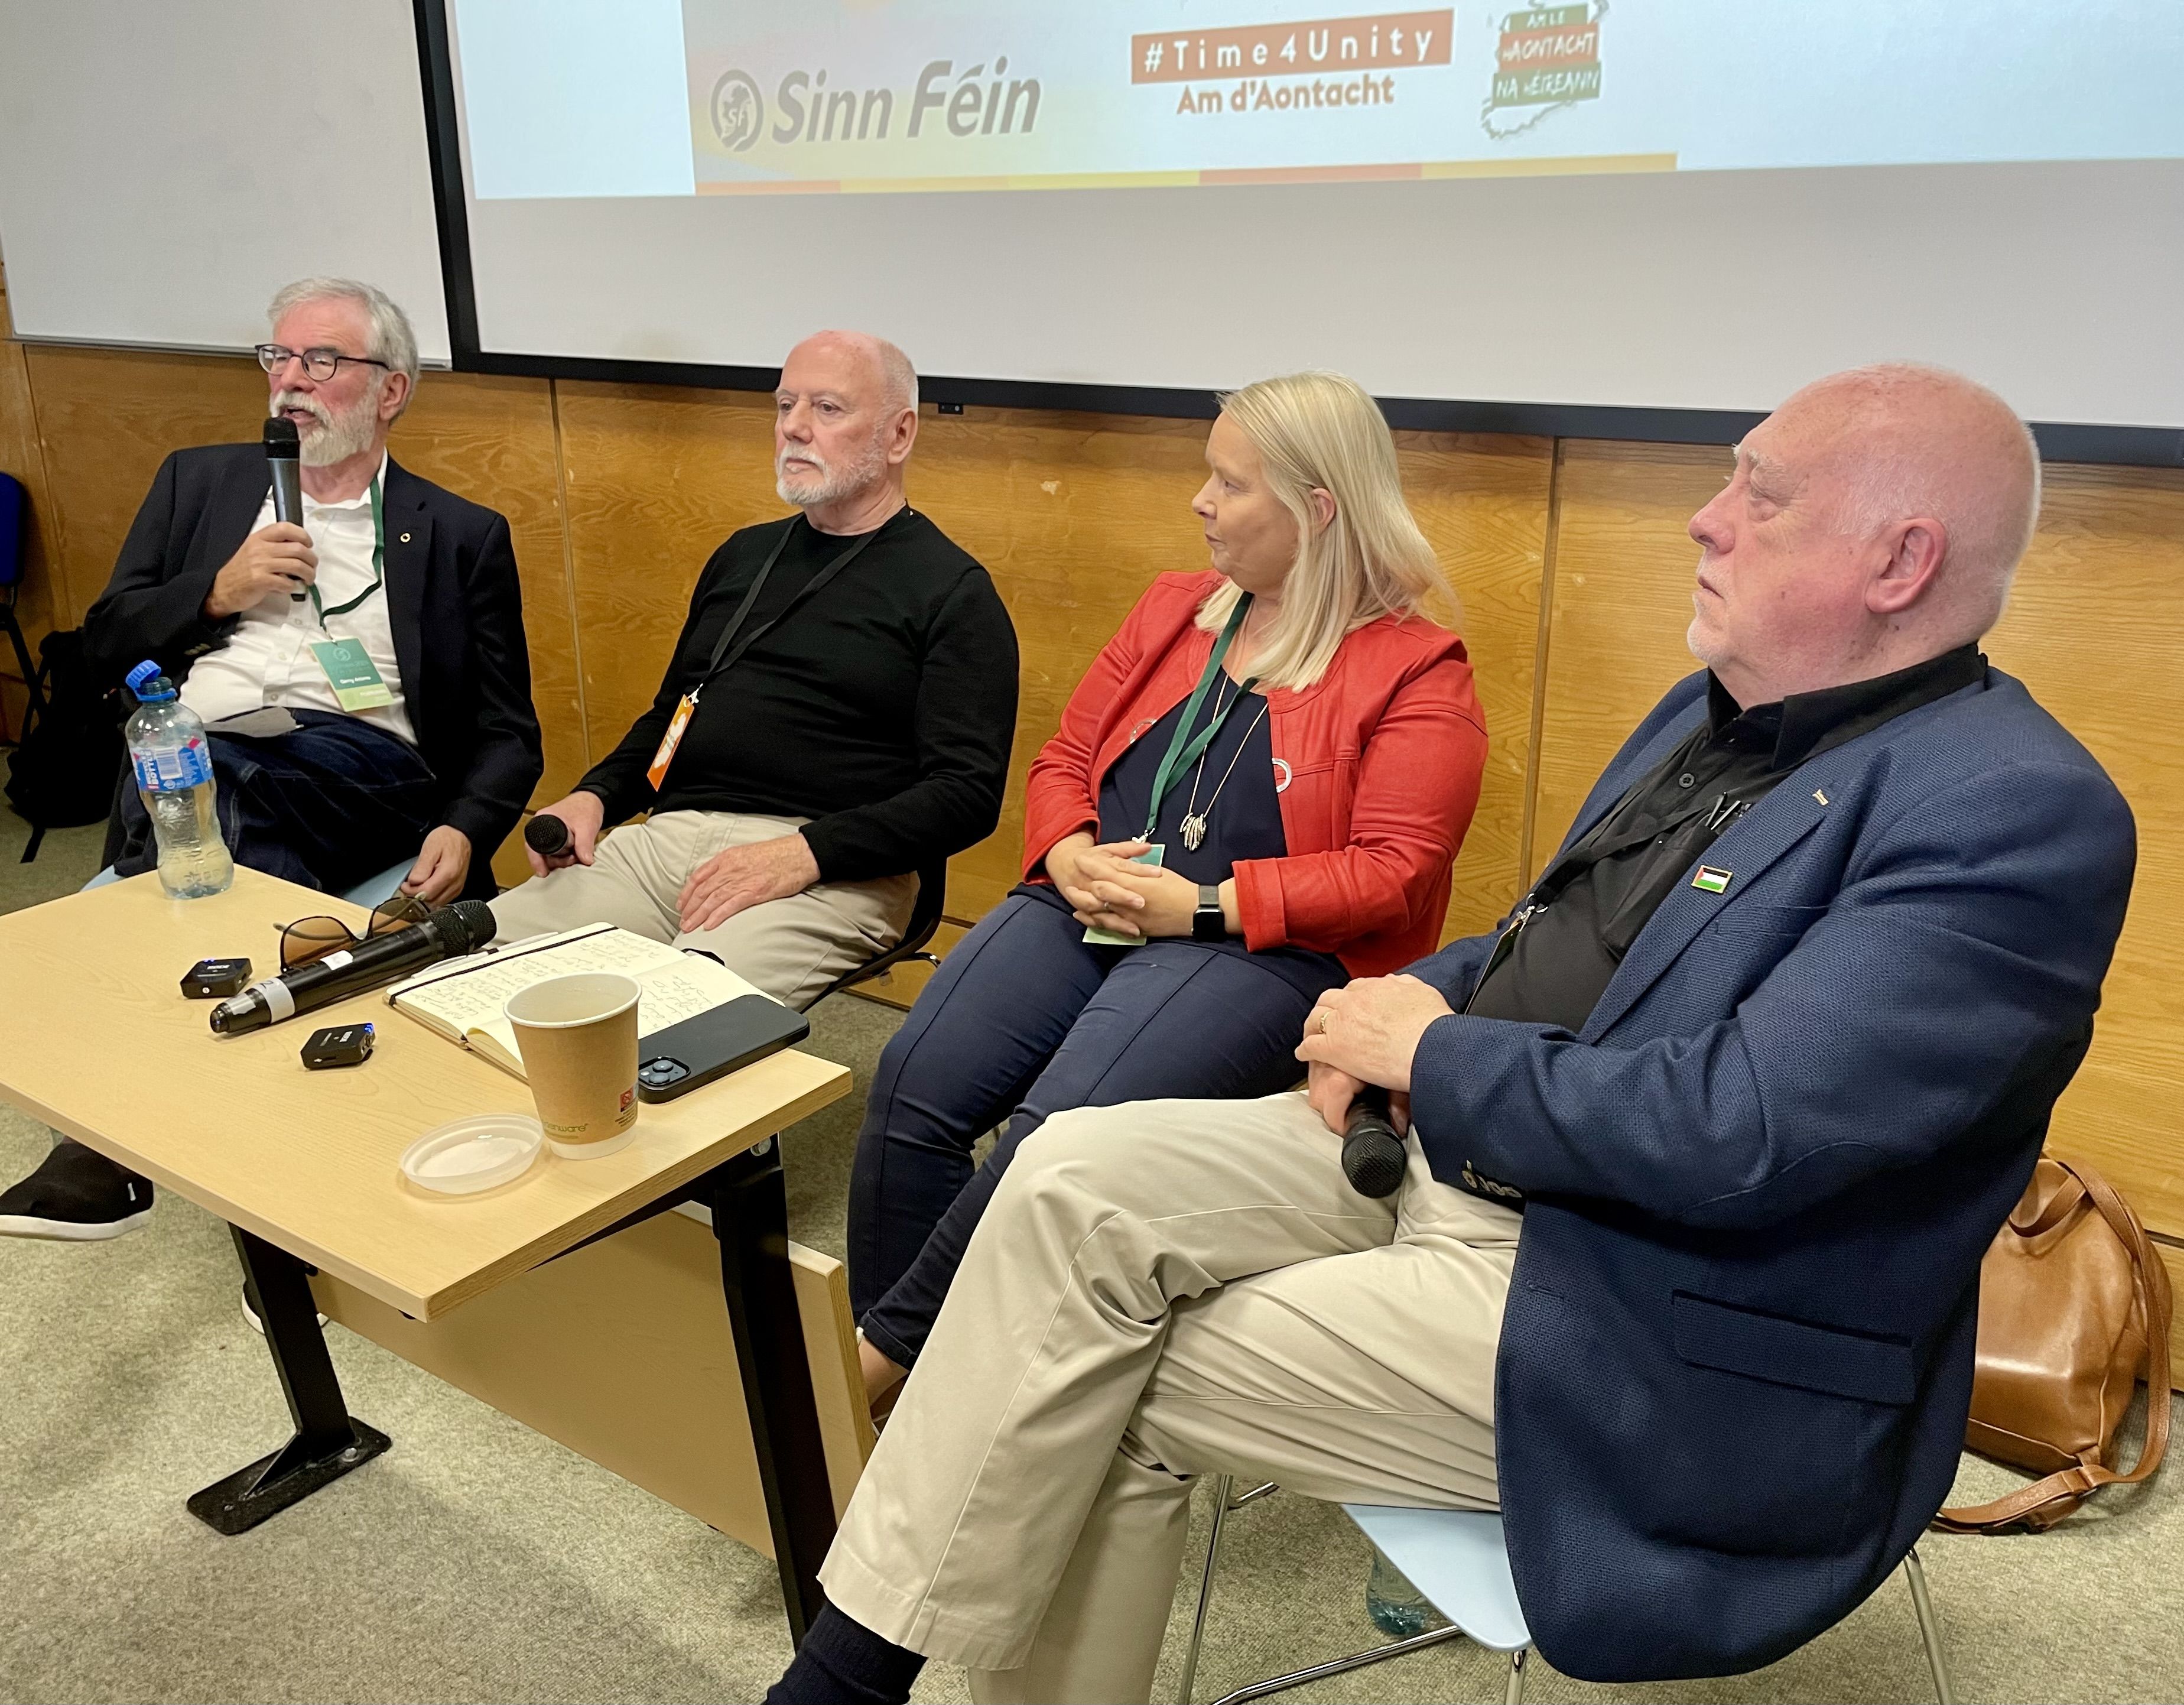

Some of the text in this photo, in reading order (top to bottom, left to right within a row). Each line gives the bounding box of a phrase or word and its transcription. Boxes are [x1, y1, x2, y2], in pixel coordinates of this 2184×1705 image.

[1143, 27, 1433, 73] #Time4Unity
[772, 56, 1040, 144] Sinn Féin
[1176, 85, 1221, 115] Am
